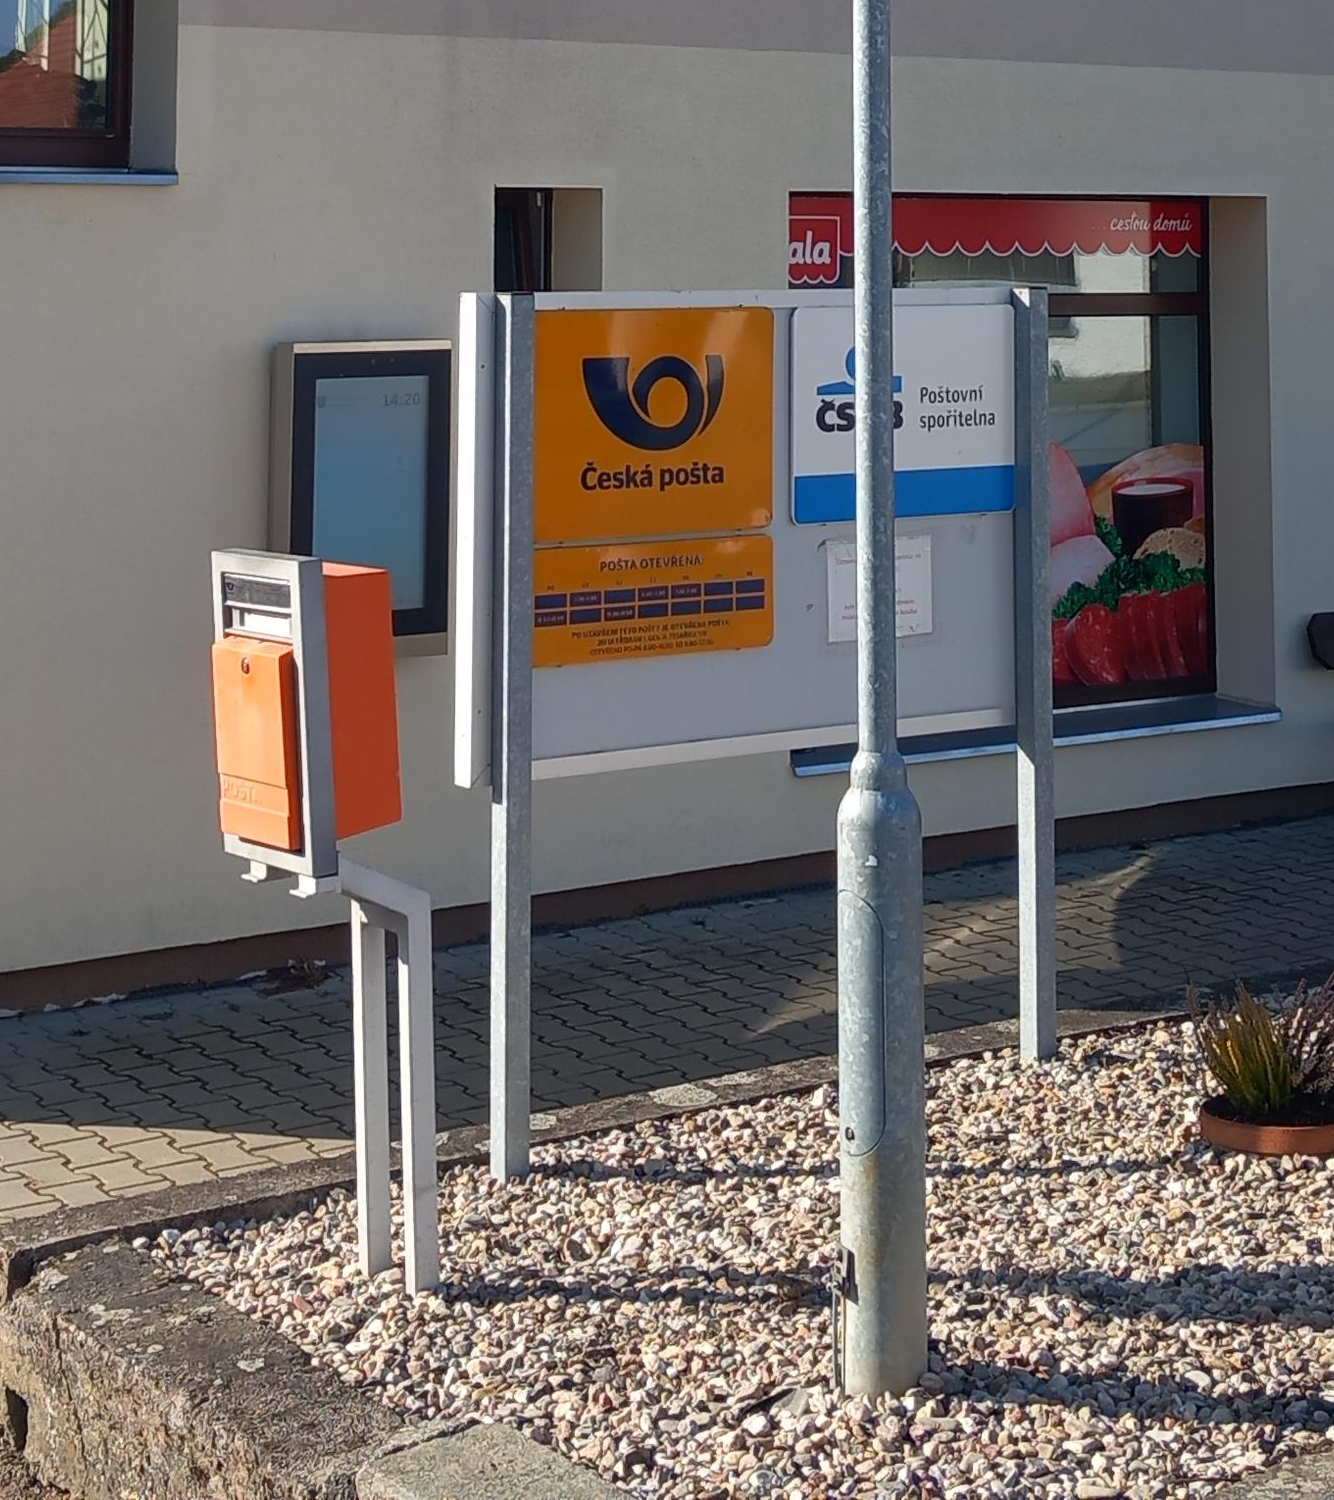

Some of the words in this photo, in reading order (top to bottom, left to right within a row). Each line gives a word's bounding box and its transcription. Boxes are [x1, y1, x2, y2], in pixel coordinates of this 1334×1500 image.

[788, 230, 831, 265] ala
[919, 384, 984, 405] Poštovní
[815, 398, 904, 433] ČSB
[919, 409, 996, 432] spořitelna
[580, 461, 653, 491] Česká
[659, 461, 725, 492] pošta
[600, 557, 638, 572] POŠTA
